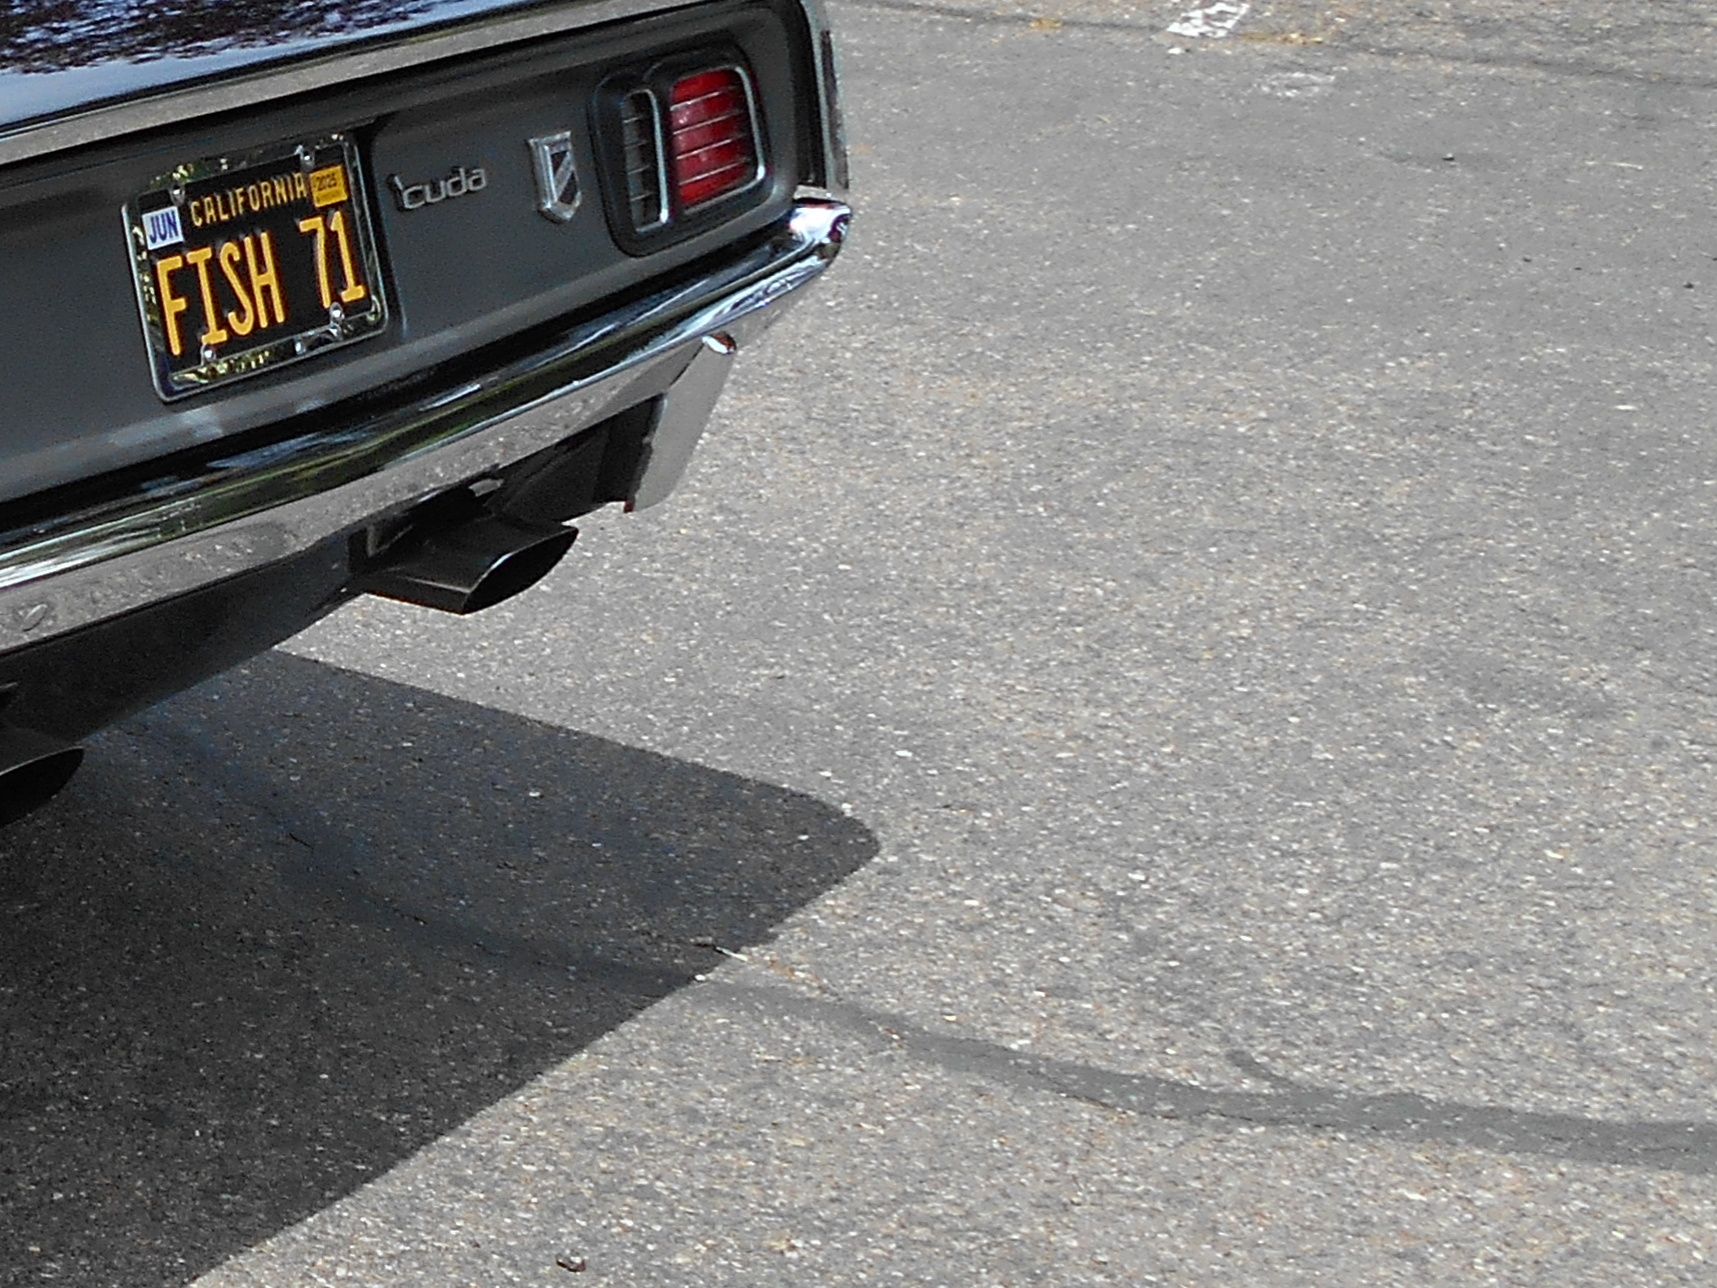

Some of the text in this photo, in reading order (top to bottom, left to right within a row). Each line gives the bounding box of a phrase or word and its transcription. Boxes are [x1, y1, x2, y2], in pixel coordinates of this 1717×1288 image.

[190, 172, 308, 227] CALIFORNIA
[148, 213, 180, 244] JUN
[156, 210, 365, 356] FISH 71
